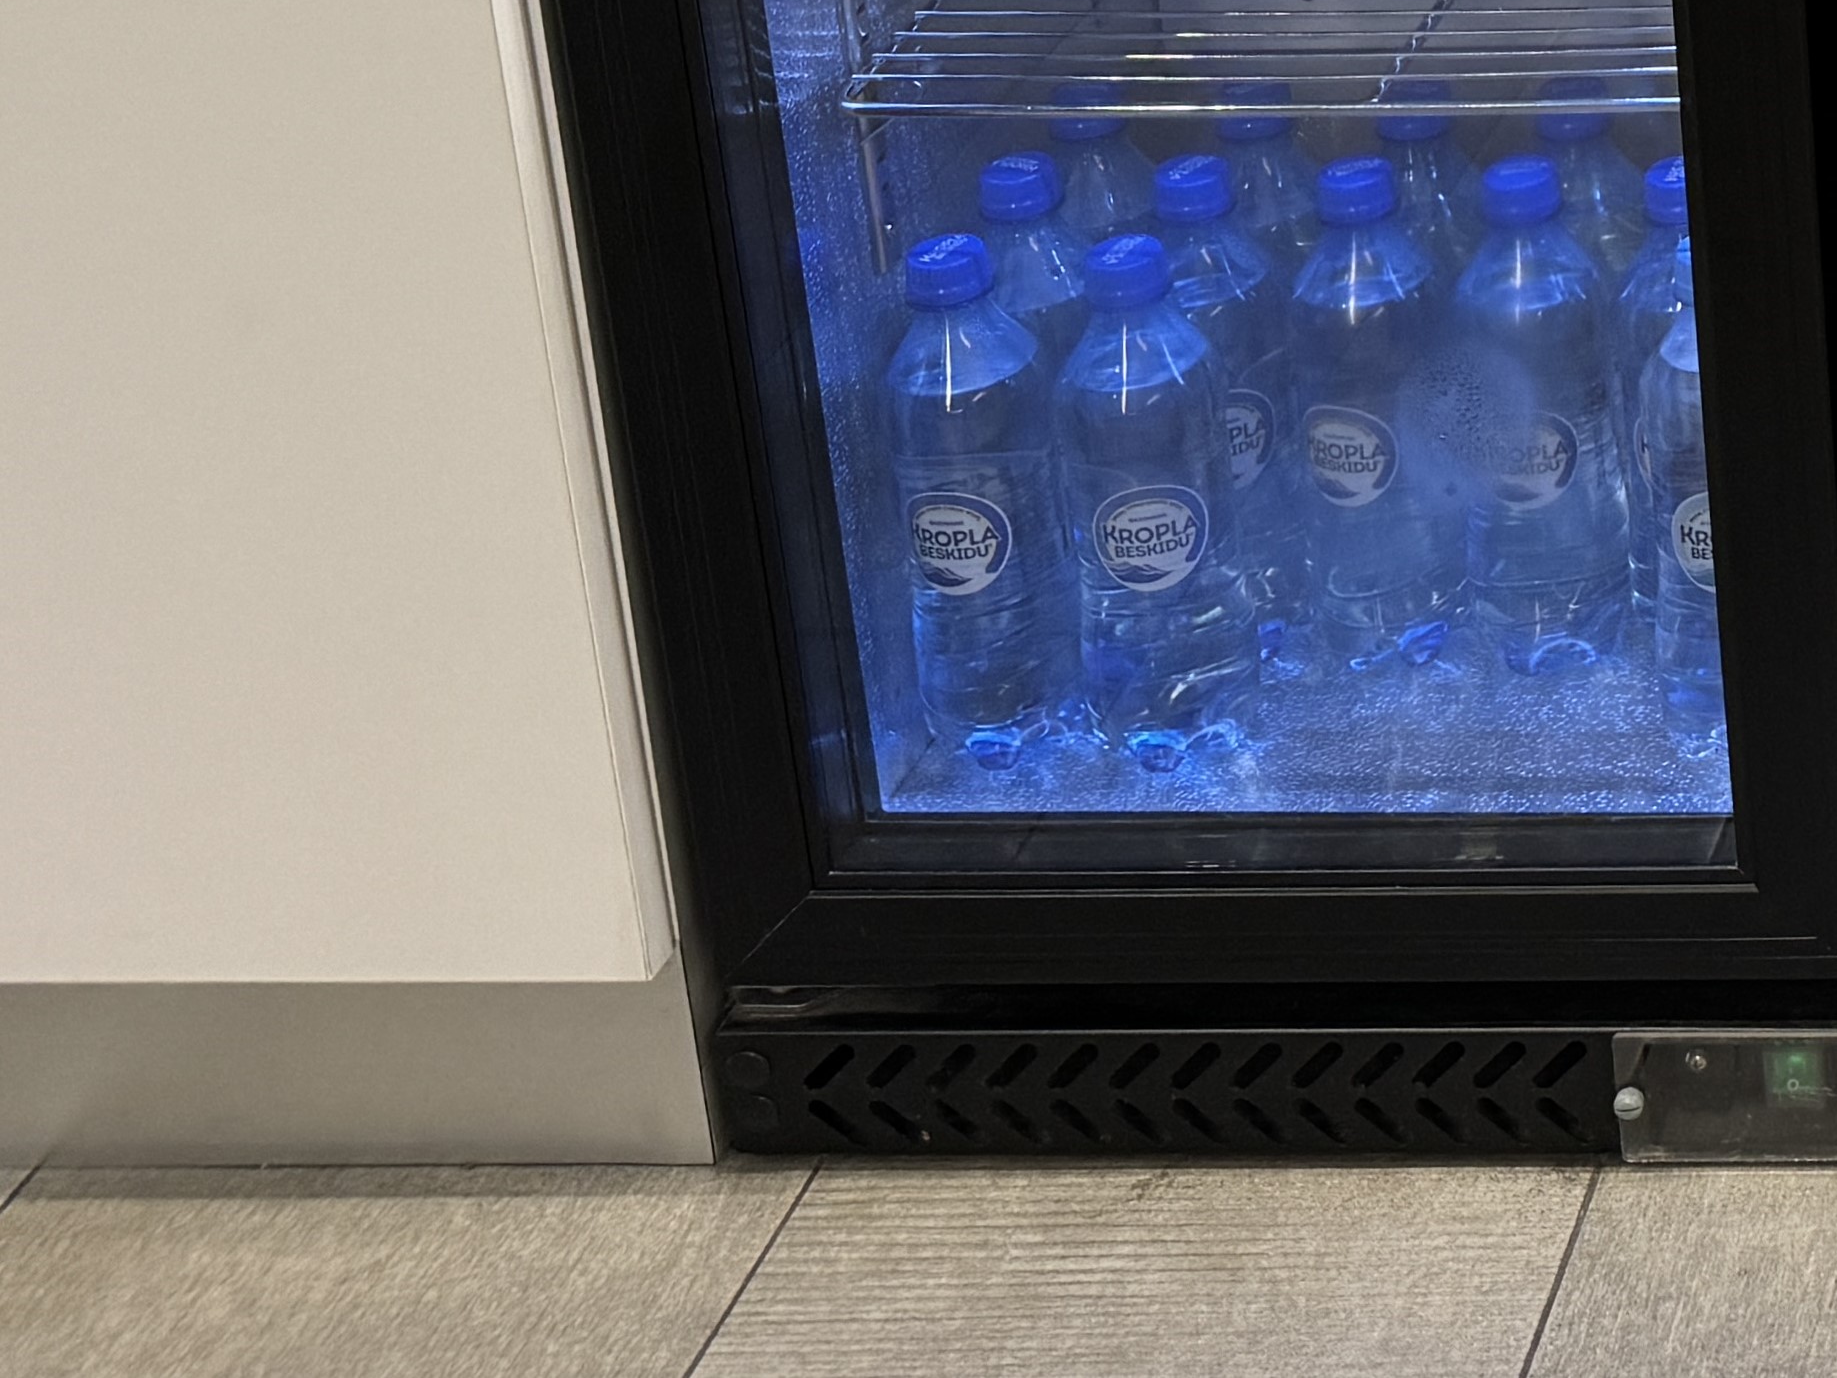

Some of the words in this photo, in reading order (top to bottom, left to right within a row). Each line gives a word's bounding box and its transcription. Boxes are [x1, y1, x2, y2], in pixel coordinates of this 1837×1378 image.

[913, 525, 999, 546] KROPLA
[1102, 515, 1198, 545] KROPLA
[919, 544, 992, 561] BESKIDU
[1115, 532, 1193, 559] BESKIDU
